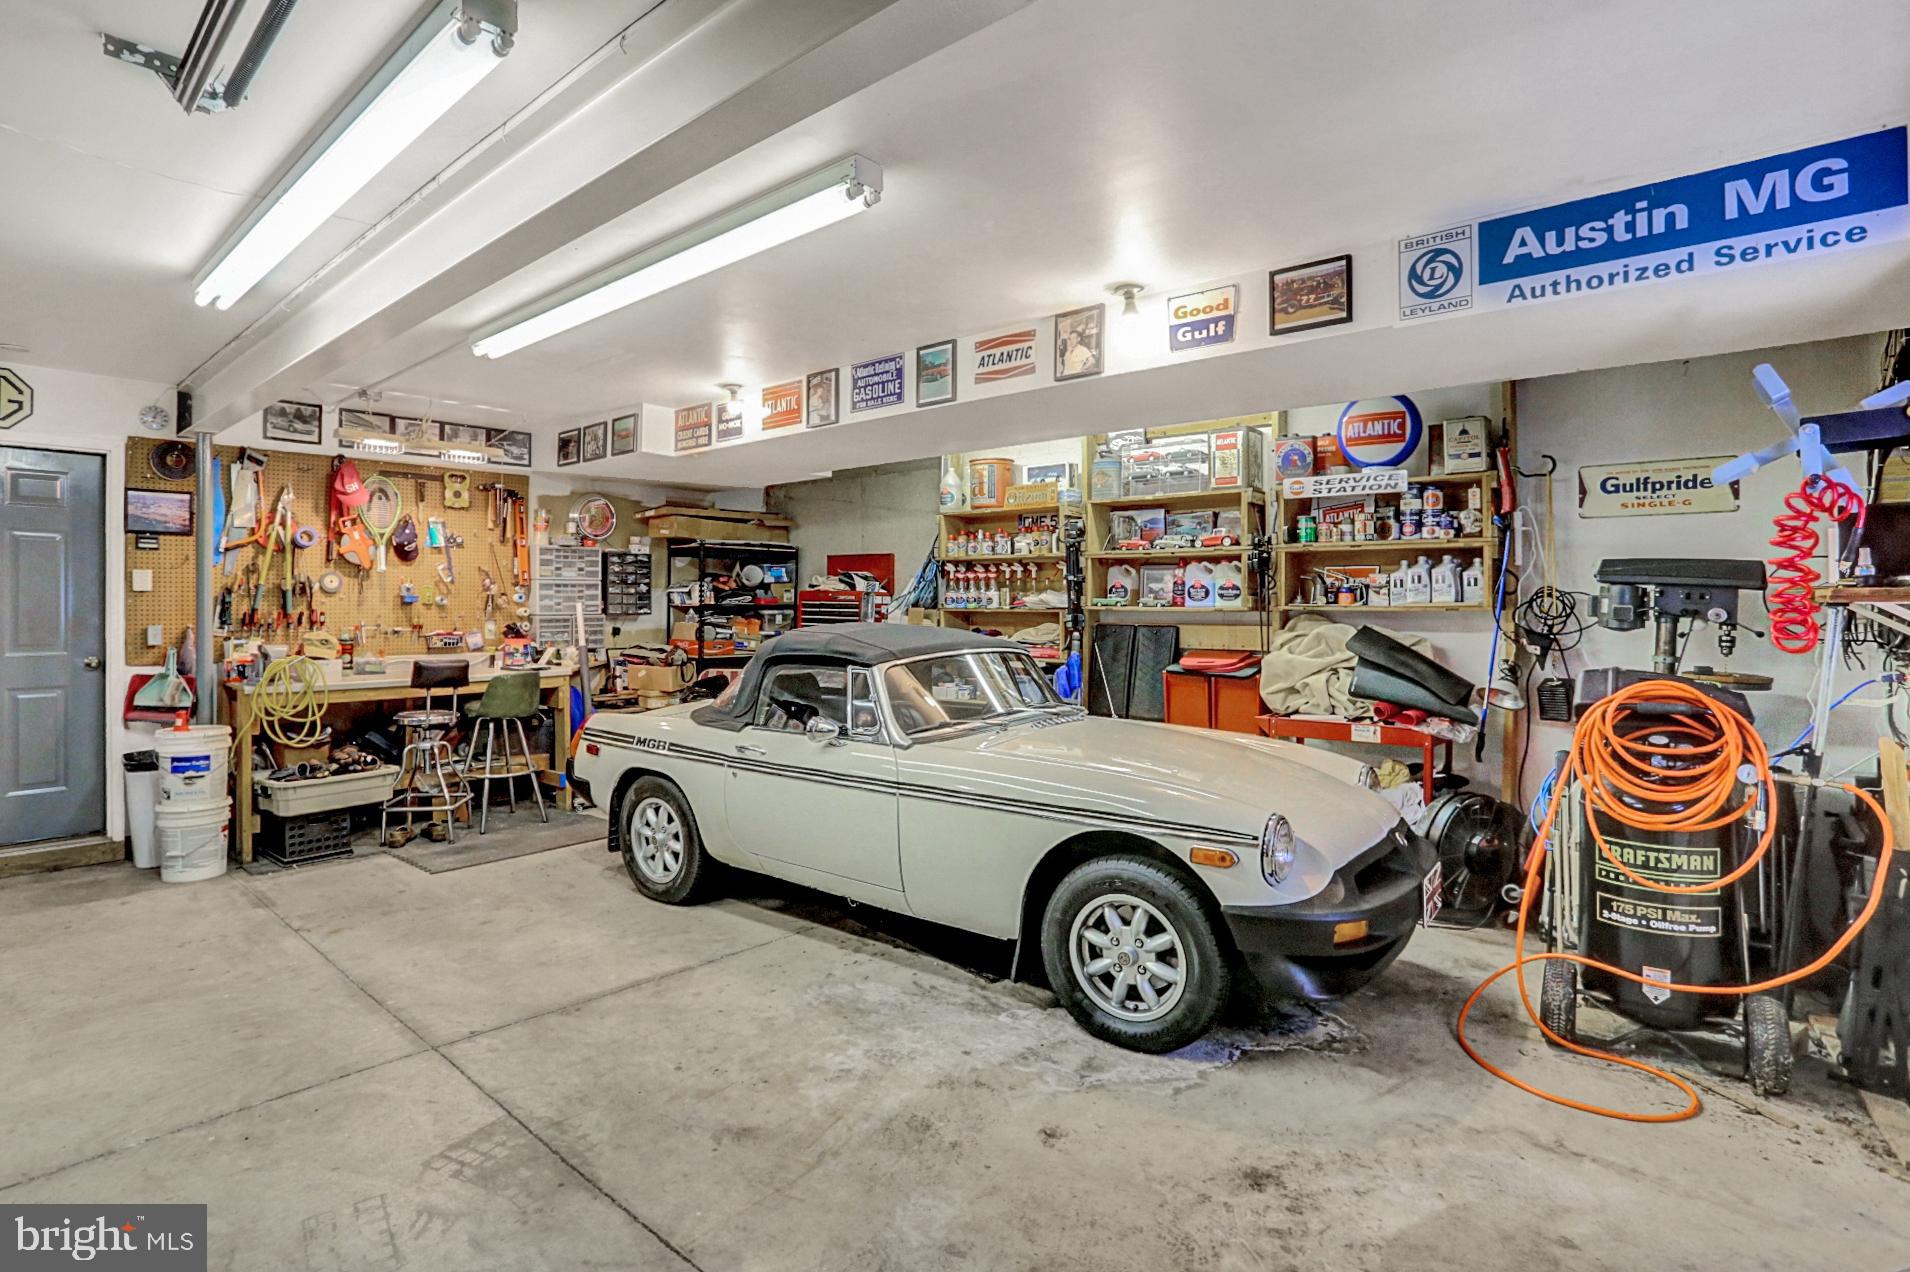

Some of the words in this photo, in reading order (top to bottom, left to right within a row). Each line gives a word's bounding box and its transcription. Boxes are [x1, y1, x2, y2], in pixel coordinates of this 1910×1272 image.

[1501, 200, 1689, 265] Austin
[1724, 157, 1850, 220] MG
[1404, 228, 1467, 250] BRITISH
[1506, 251, 1696, 304] Authorized
[1713, 223, 1869, 268] Service
[1173, 297, 1230, 321] Good
[1402, 298, 1470, 317] LEYLAND
[1176, 320, 1227, 342] Gulf
[978, 346, 1033, 369] ATLANTIC
[857, 370, 898, 387] AUTOMOBILE
[0, 375, 23, 421] G
[853, 379, 902, 401] GASOLINE
[678, 406, 708, 427] ATLANTIC
[1347, 418, 1403, 439] ATLANTIC
[1448, 434, 1481, 443] CAPITOL
[1311, 482, 1399, 495] STATION
[1312, 472, 1401, 487] SERVICE
[1600, 473, 1714, 495] Gulfpride
[1620, 499, 1693, 510] SINGLE-G
[1635, 493, 1677, 501] SELECT
[635, 736, 667, 751] MGB
[1602, 909, 1639, 925] 2-Stage
[1688, 924, 1717, 933] Pump
[1611, 901, 1634, 915] 175
[1636, 906, 1663, 920] PSI
[1666, 910, 1702, 923] Max.
